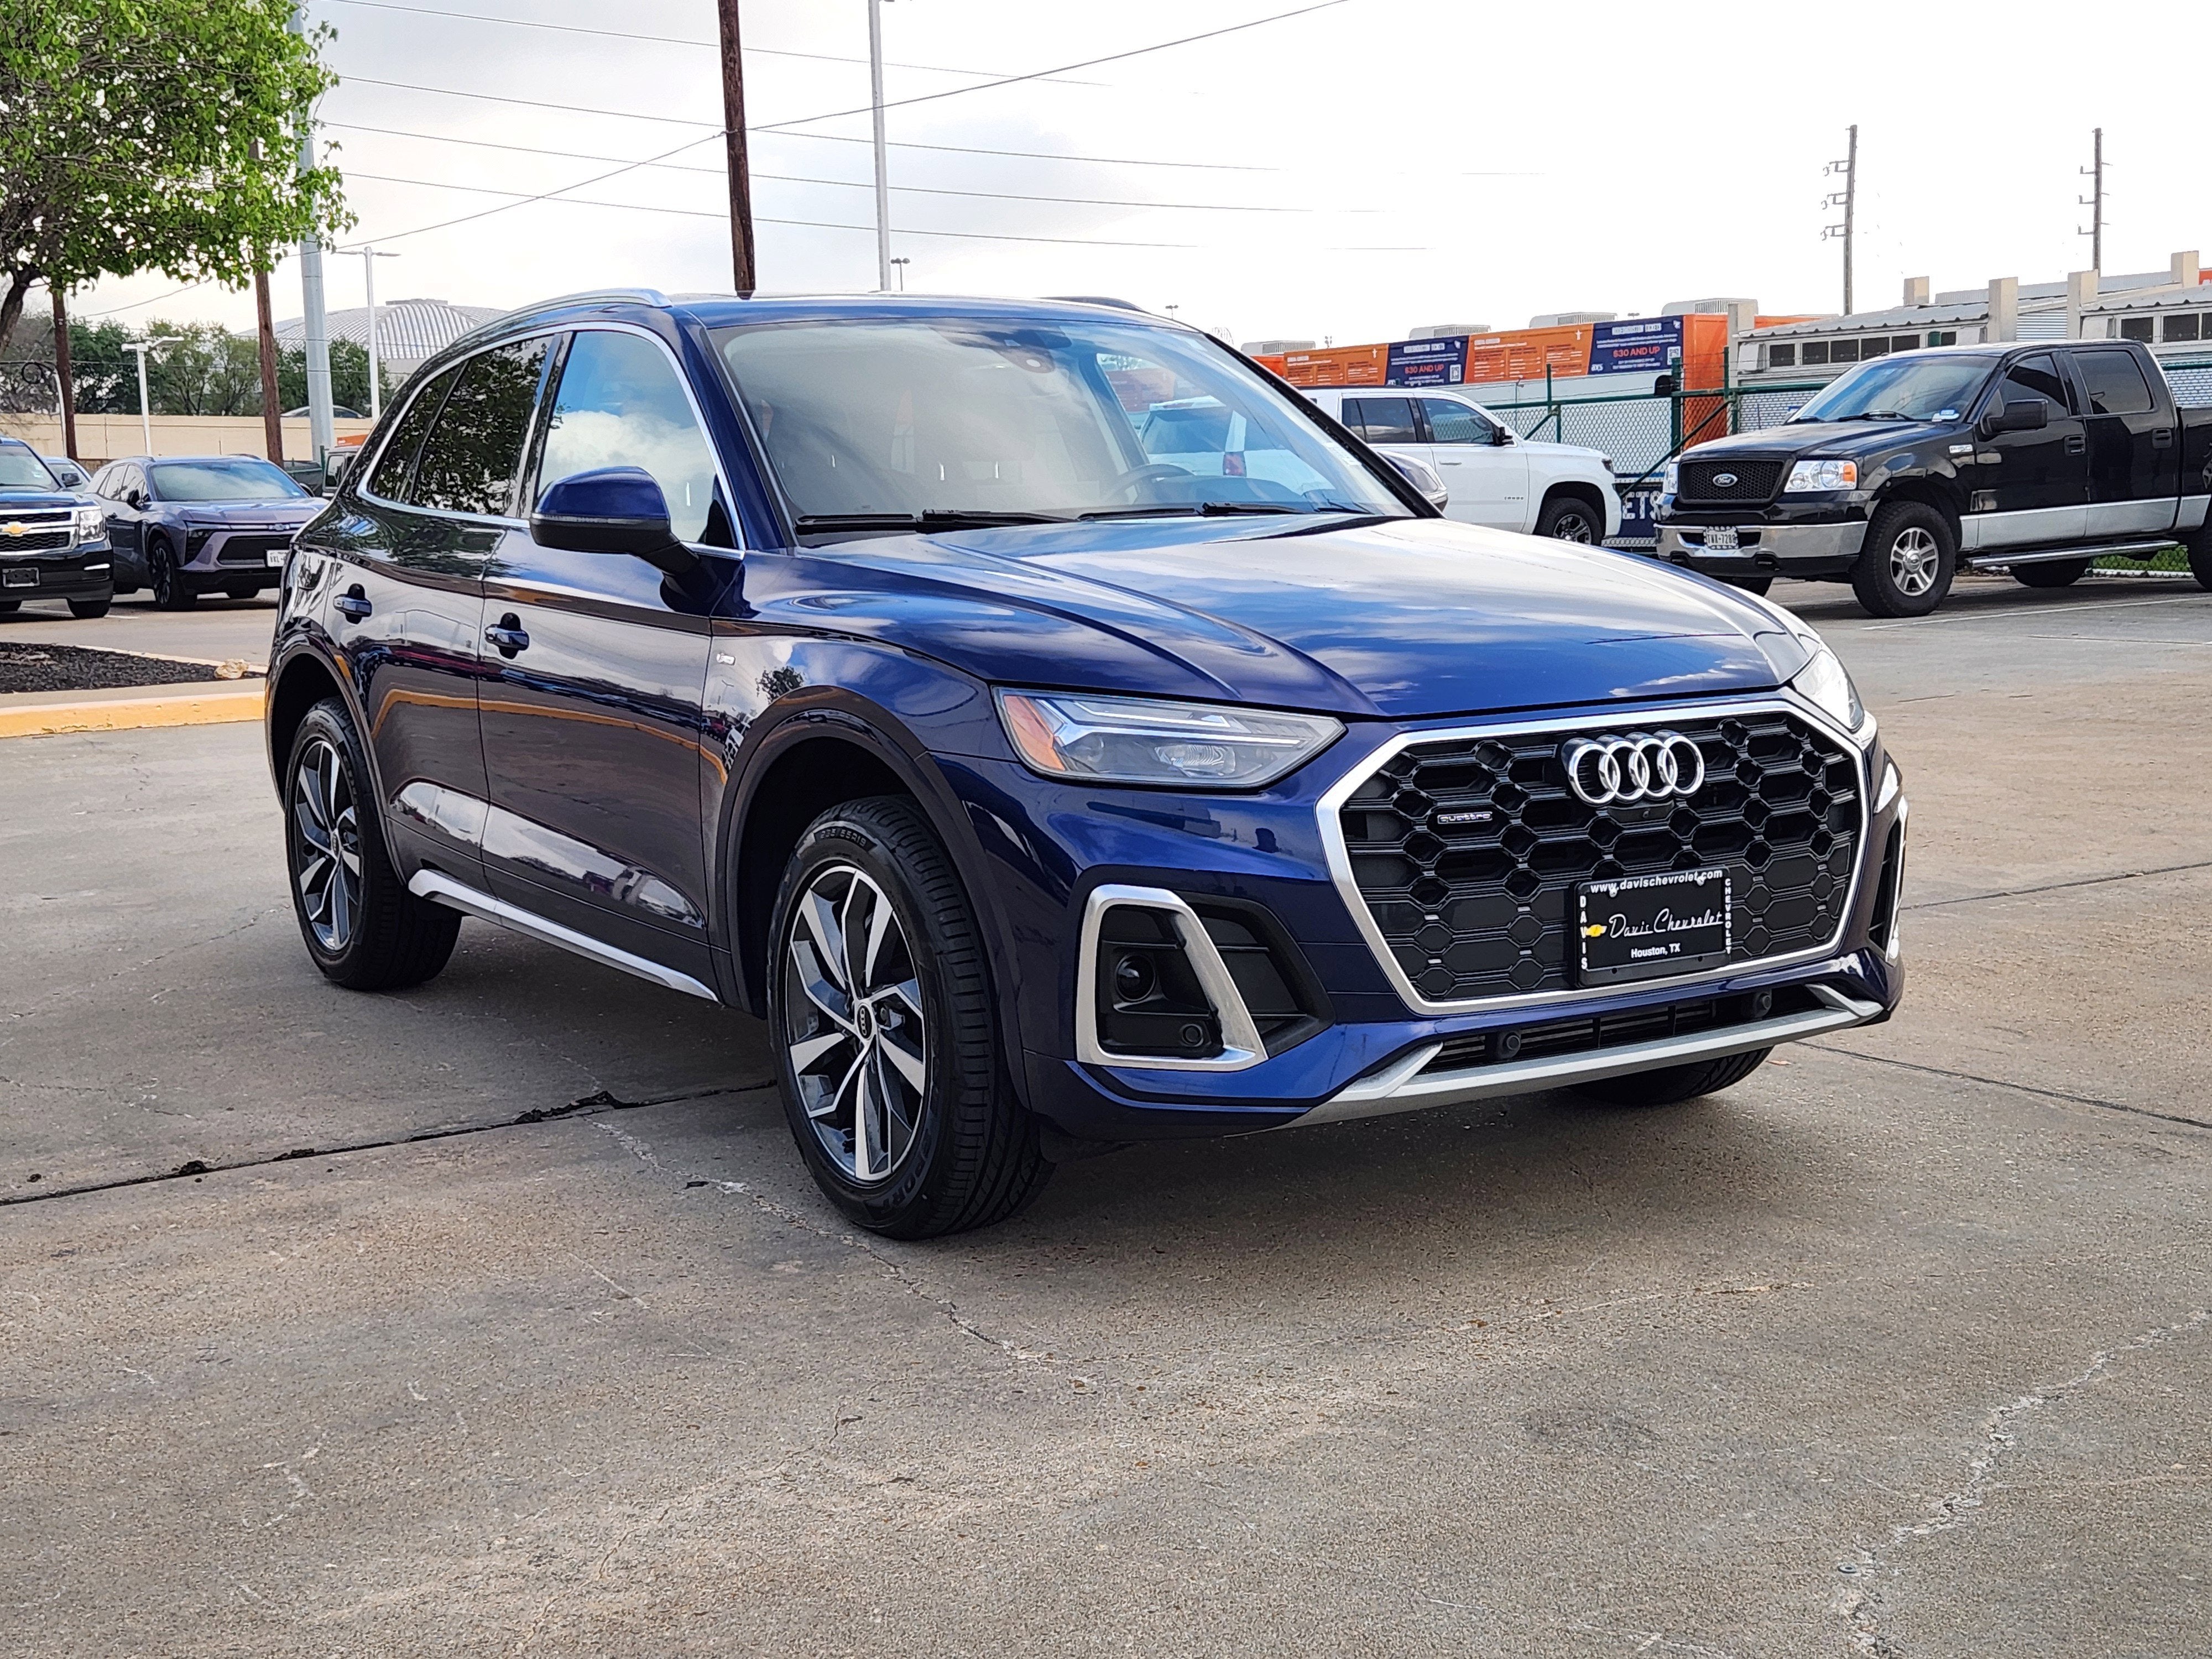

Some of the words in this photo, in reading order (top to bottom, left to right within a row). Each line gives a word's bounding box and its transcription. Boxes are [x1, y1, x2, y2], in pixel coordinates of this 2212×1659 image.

[1613, 349, 1629, 358] $30
[1630, 347, 1647, 356] AND
[1648, 346, 1661, 354] UP
[1439, 813, 1491, 823] quattro
[1590, 870, 1723, 894] www.davischevrolet.com
[1579, 895, 1588, 970] DAVIS
[1609, 914, 1653, 938] Davis
[1653, 908, 1724, 933] Chevrolet
[1631, 946, 1667, 958] Houston,
[1669, 943, 1681, 953] TX
